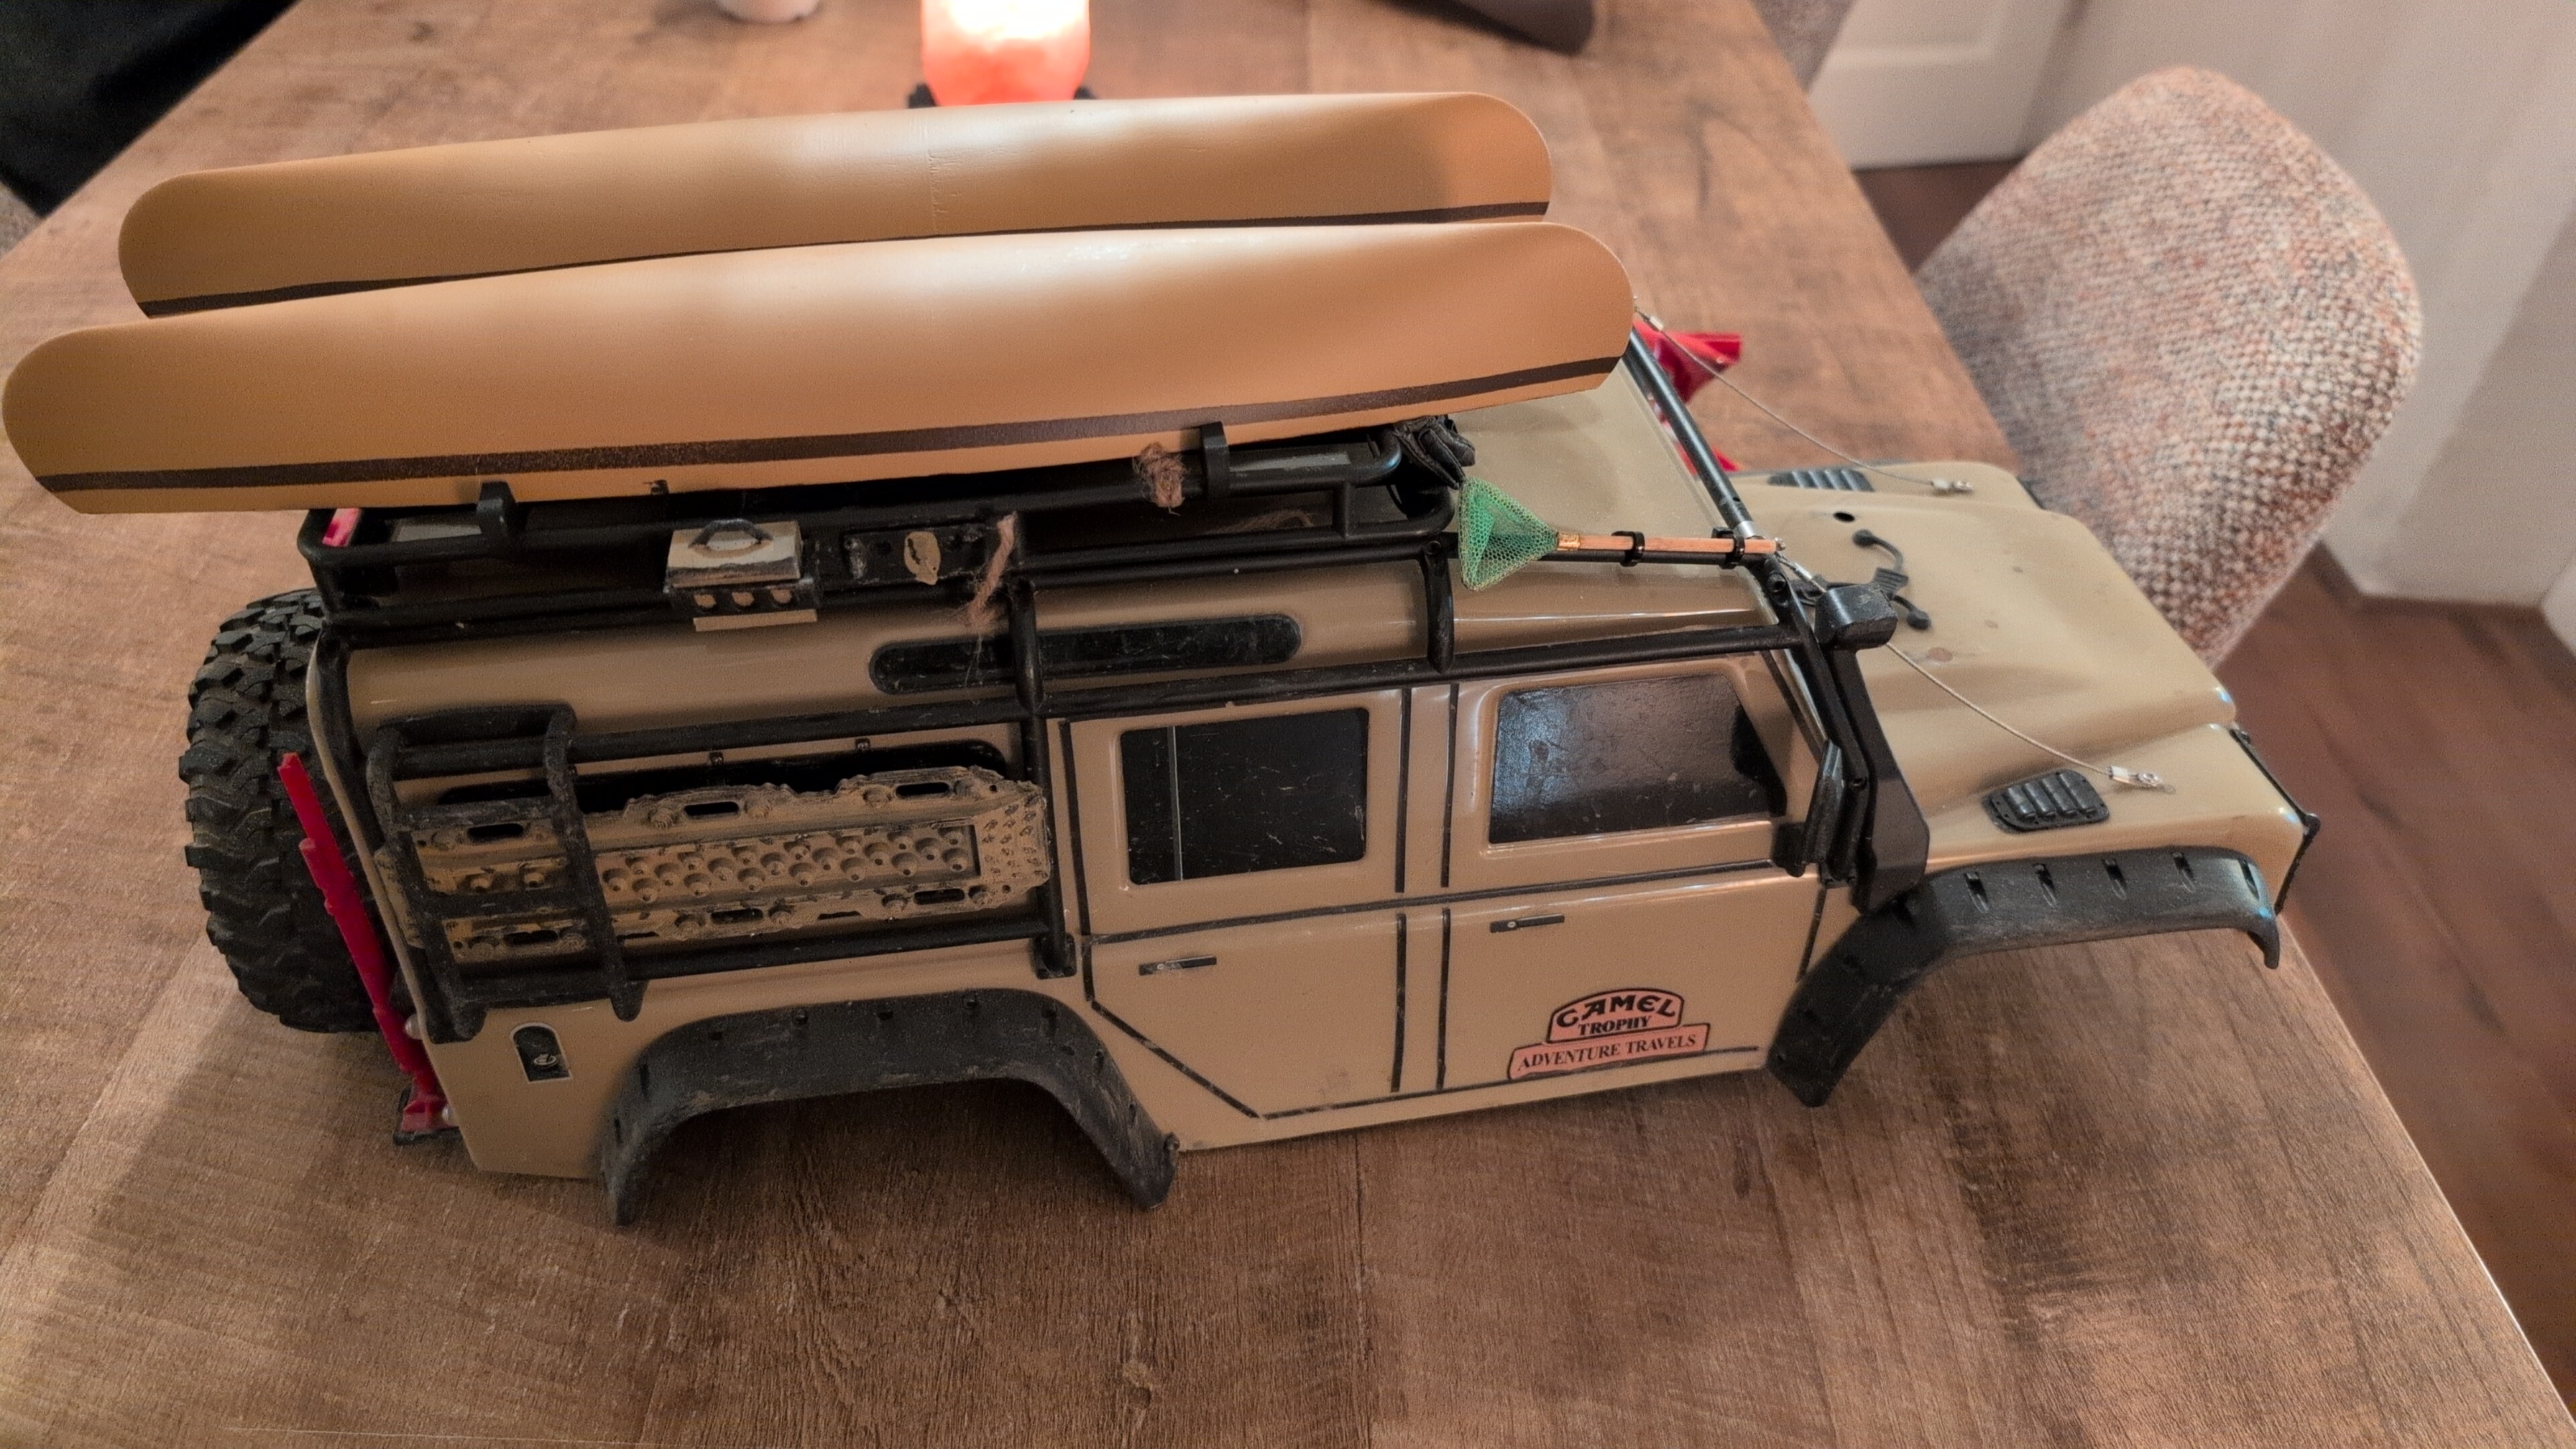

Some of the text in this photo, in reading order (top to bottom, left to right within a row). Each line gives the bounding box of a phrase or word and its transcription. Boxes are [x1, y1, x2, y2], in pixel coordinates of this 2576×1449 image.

[1556, 994, 1676, 1028] CAMEL
[1577, 1015, 1652, 1036] TROPHY
[1517, 1034, 1697, 1071] ADVENTURE TRAVELS
